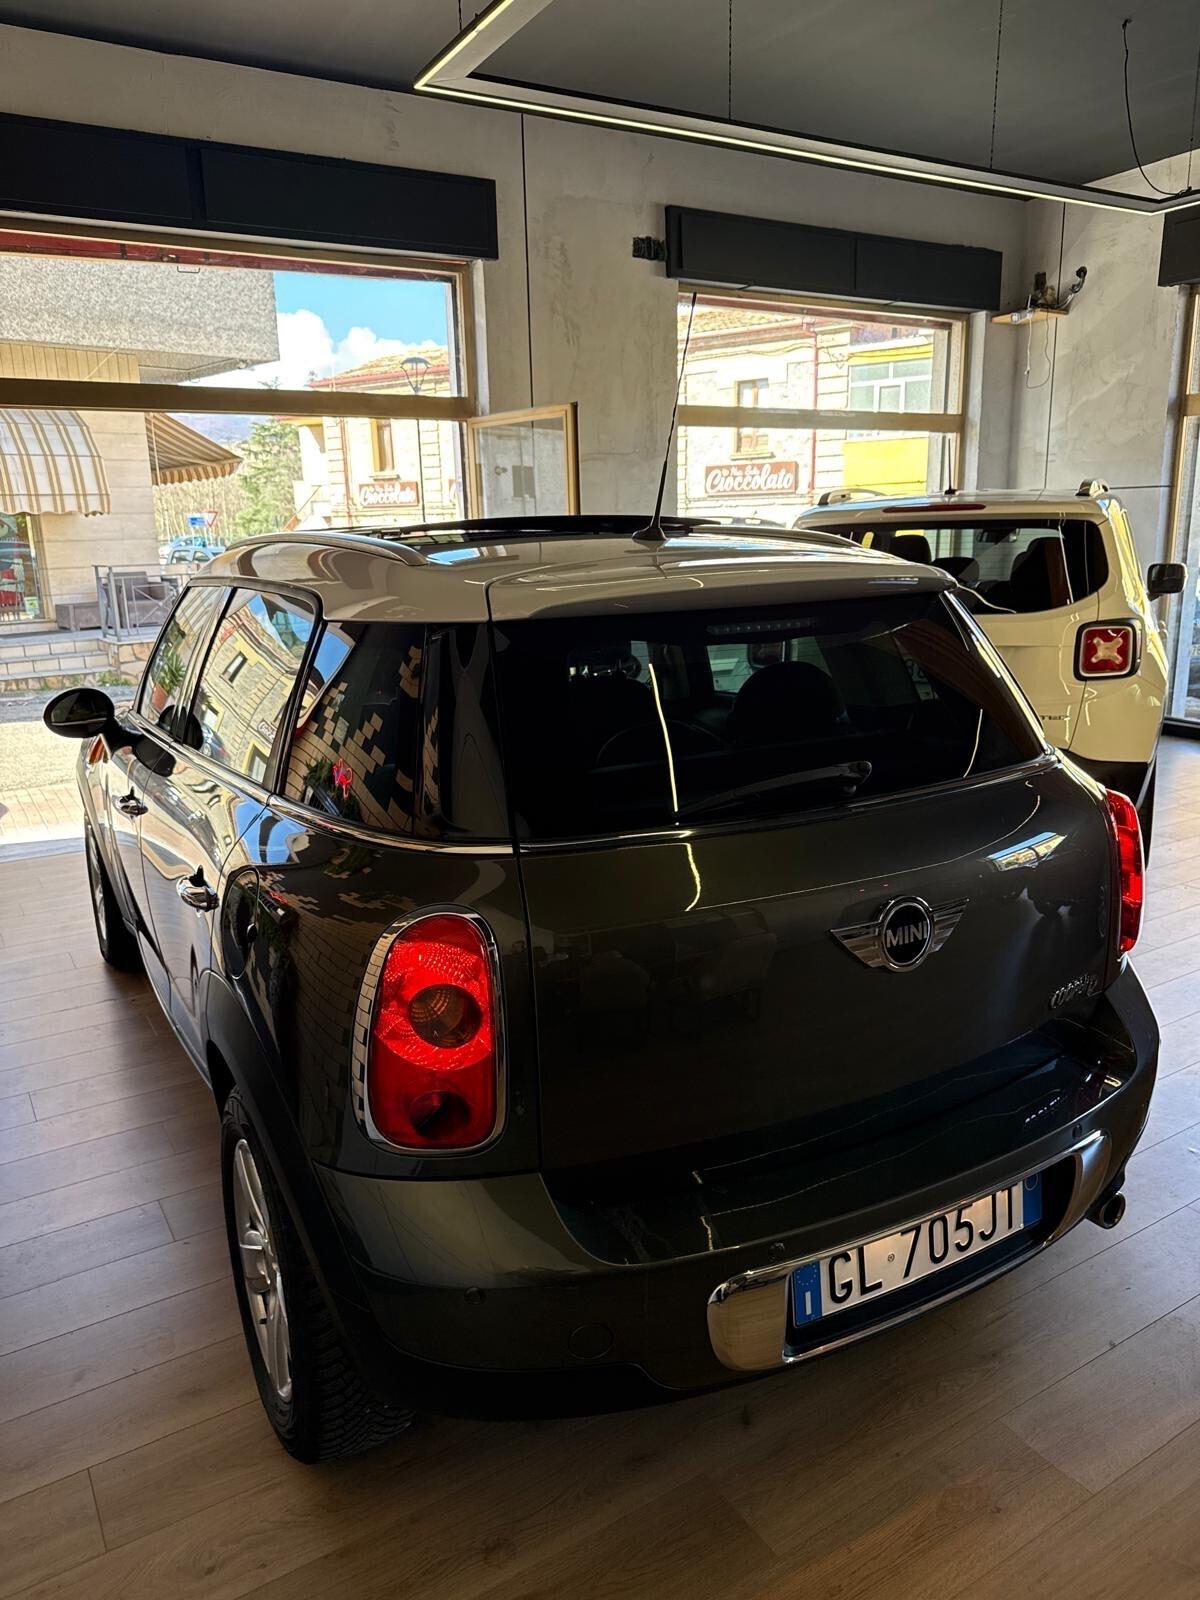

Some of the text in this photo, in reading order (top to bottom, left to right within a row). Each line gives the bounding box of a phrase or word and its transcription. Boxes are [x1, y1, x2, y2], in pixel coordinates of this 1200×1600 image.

[706, 463, 793, 494] Cioccolato
[886, 920, 928, 948] MINI
[829, 1182, 1018, 1304] GL 705JT
